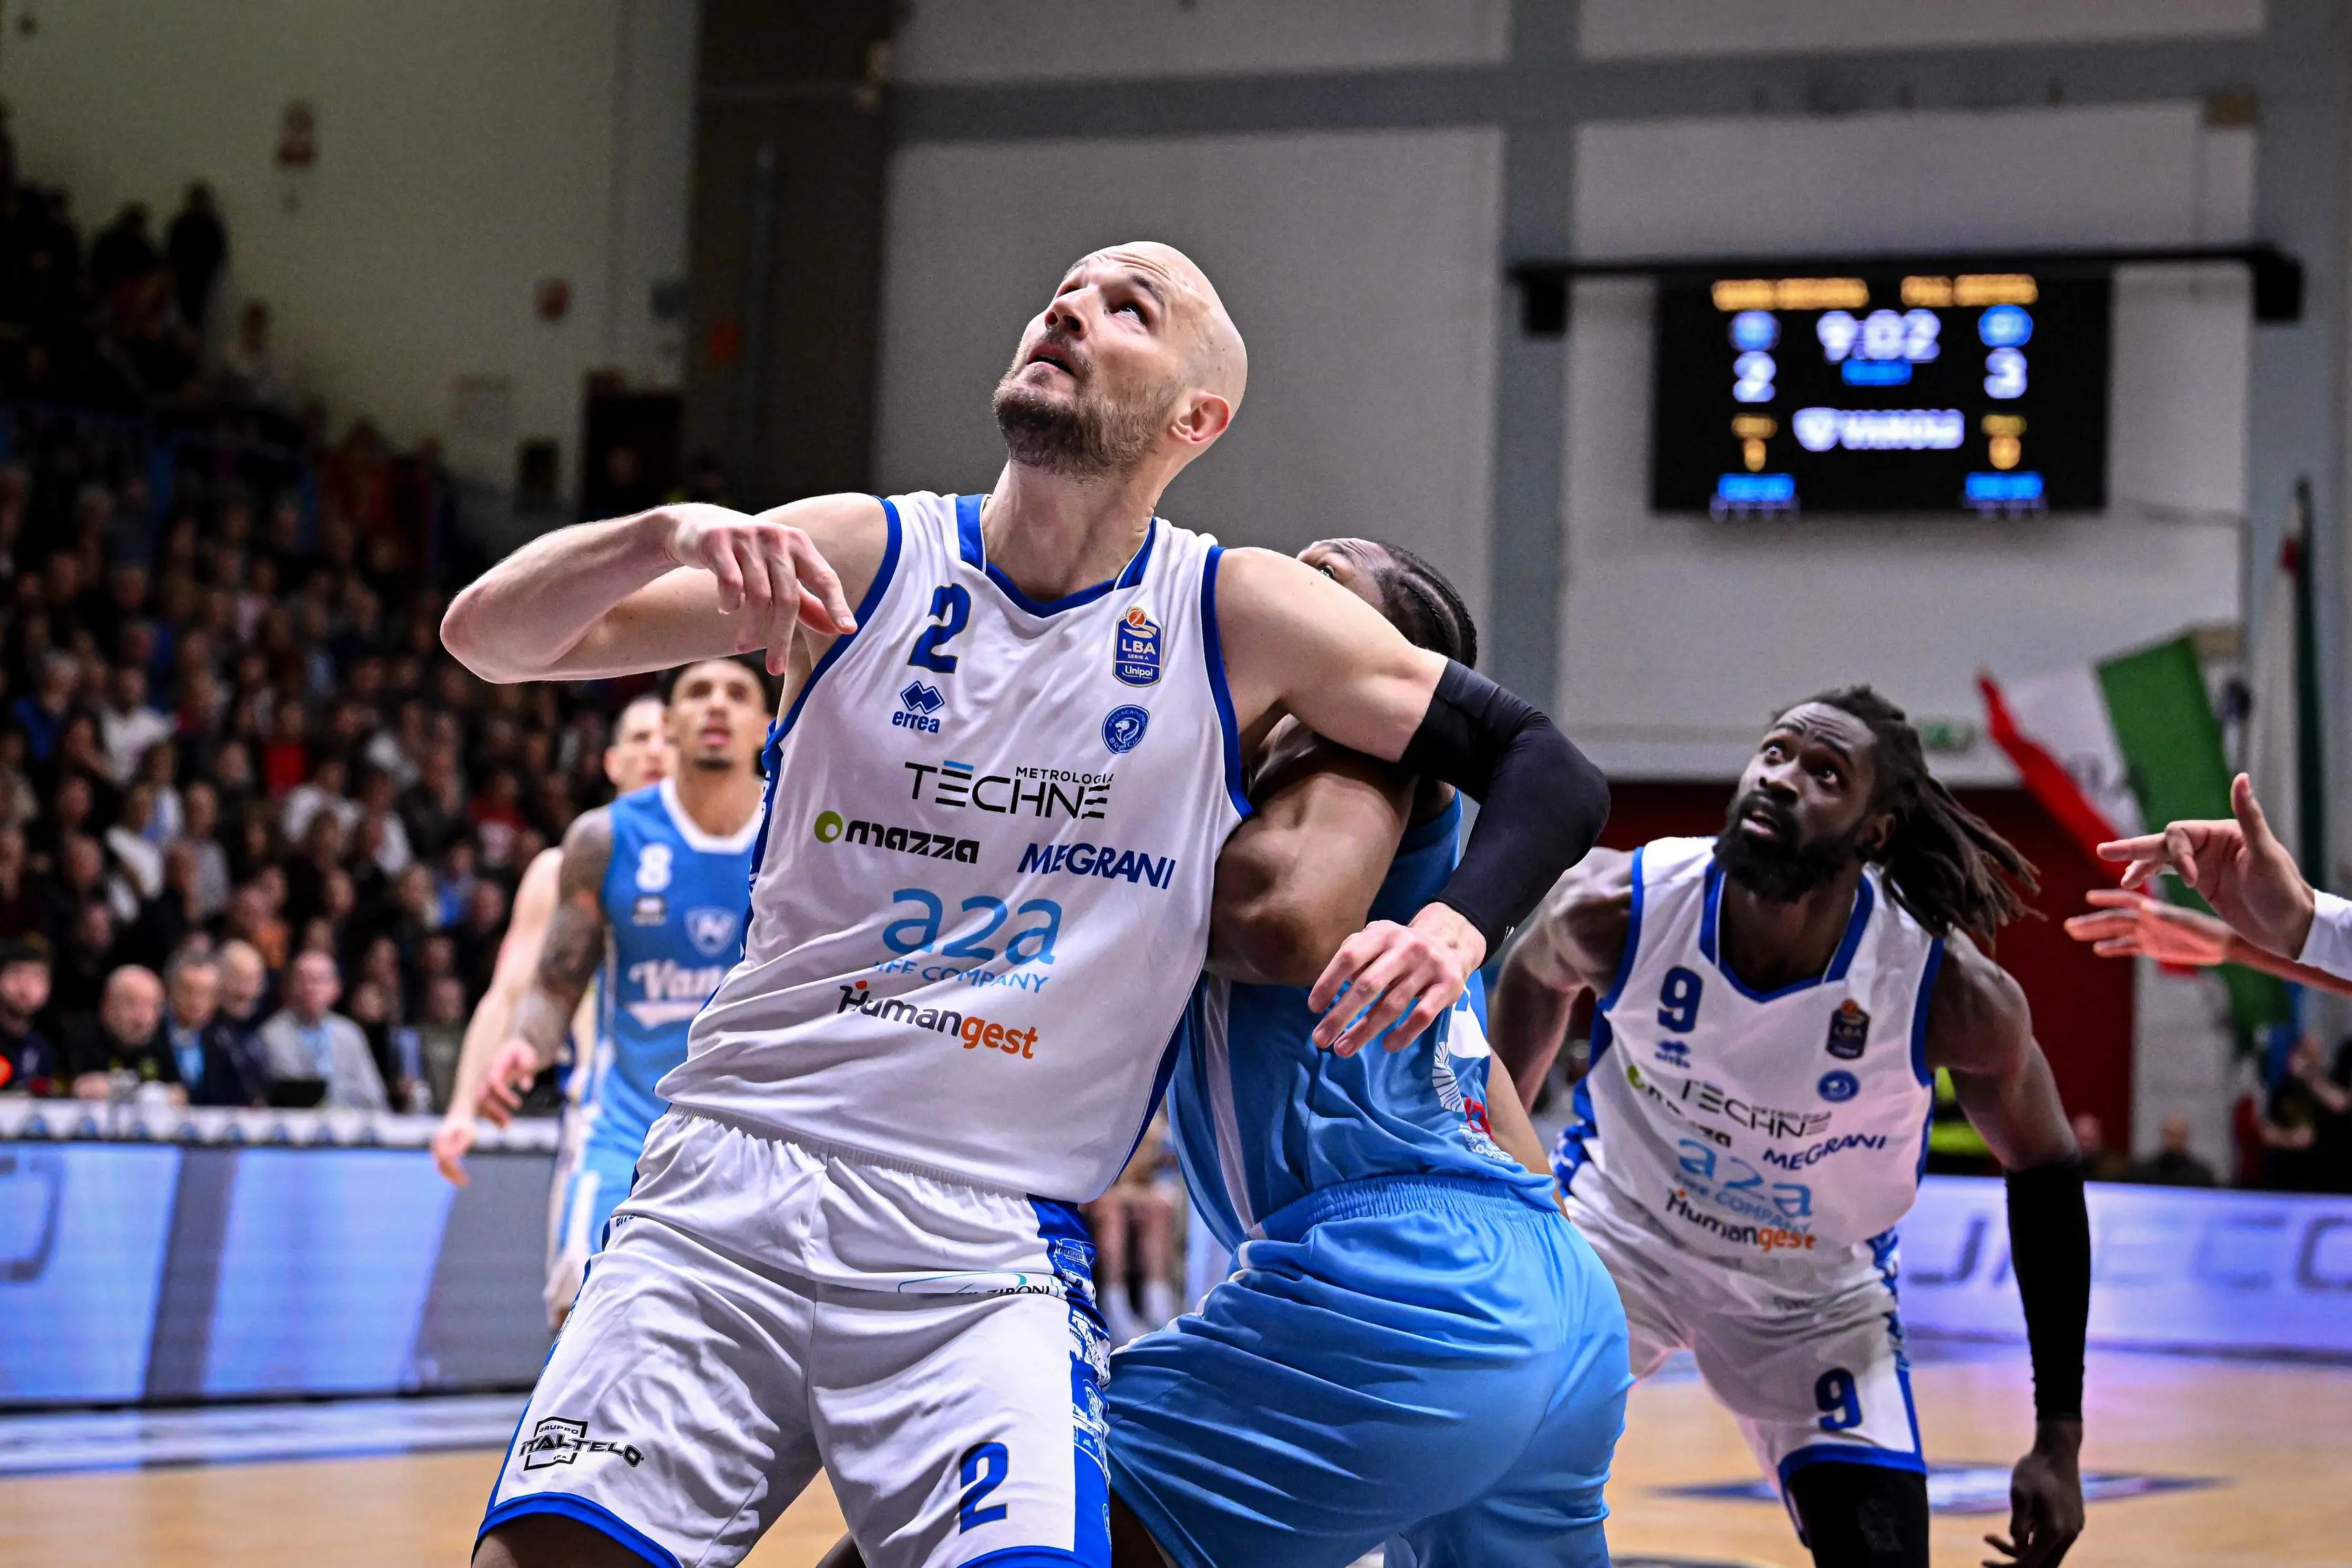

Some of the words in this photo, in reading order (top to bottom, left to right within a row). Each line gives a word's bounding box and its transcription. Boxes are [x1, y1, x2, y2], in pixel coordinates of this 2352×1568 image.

[907, 583, 971, 674] 2
[1122, 639, 1156, 655] LBA
[1124, 664, 1153, 679] Unipol
[891, 710, 940, 734] errea
[1108, 737, 1138, 751] BRCIA
[1015, 766, 1115, 785] METROLOGIA
[845, 820, 980, 864] mazza
[635, 843, 673, 892] 8
[1017, 843, 1177, 890] MEGRANI
[883, 888, 1063, 965] a2a
[628, 958, 722, 1002] Van
[921, 966, 1049, 993] COMPANY
[1658, 966, 1703, 1033] 9
[837, 980, 1039, 1059] Humangest
[1762, 1133, 1887, 1170] MEGRANI
[1678, 1139, 1813, 1217] a2a
[1666, 1187, 1817, 1254] Humangest
[1815, 1367, 1862, 1432] 9
[519, 1434, 642, 1468] ITALTELO
[958, 1441, 1010, 1536] 2
